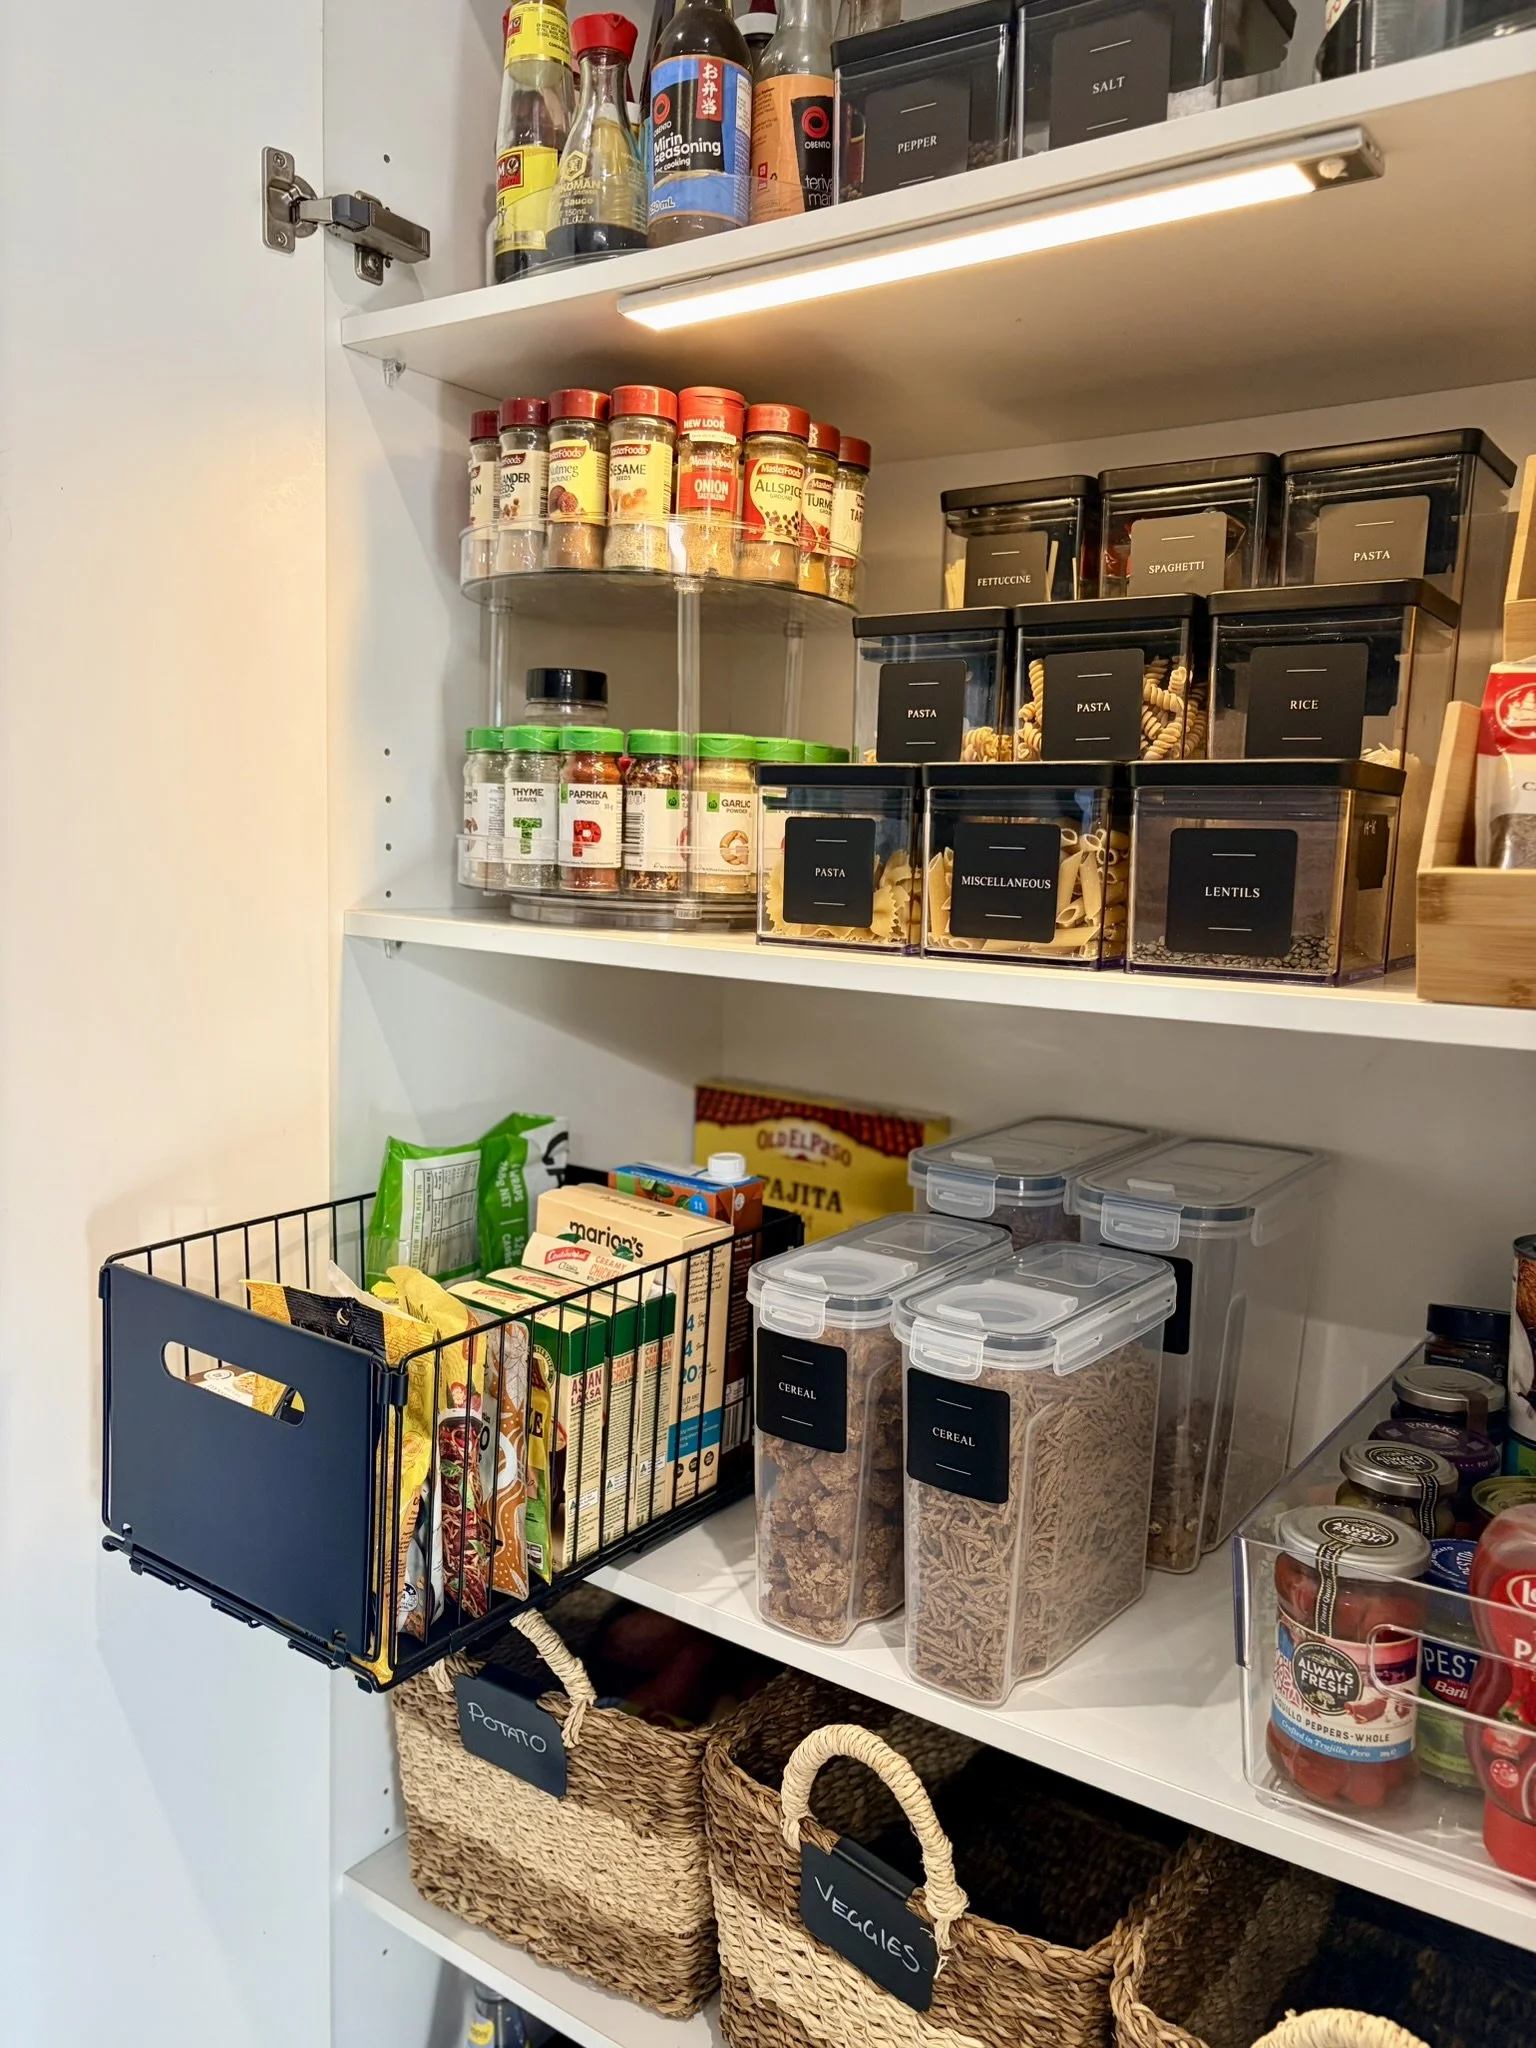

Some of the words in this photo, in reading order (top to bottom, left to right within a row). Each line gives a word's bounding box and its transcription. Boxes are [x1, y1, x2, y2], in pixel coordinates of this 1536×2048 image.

[701, 62, 719, 116] お弁当
[1091, 76, 1126, 95] SALT
[654, 132, 683, 152] Mirin
[804, 140, 832, 150] OBENTO
[898, 135, 938, 154] PEPPER
[654, 137, 722, 167] seasoning
[664, 157, 691, 172] cooking
[683, 419, 702, 429] NEW
[702, 418, 726, 429] LOOK
[609, 462, 647, 477] SESAME
[761, 464, 803, 478] MasterFoods
[694, 479, 729, 496] ONION
[1352, 548, 1391, 563] PASTA
[1147, 560, 1206, 576] SPAGHETTI
[977, 574, 1032, 588] FETTUCCINE
[1076, 701, 1111, 714] PASTA
[1289, 698, 1319, 711] RICE
[907, 708, 937, 719] PASTA
[512, 788, 544, 797] THYME
[569, 790, 608, 799] PAPRIKA
[721, 799, 751, 808] GARLIC
[814, 867, 846, 878] PASTA
[960, 874, 1052, 890] MISCELLANEOUS
[1205, 885, 1261, 899] LENTILS
[500, 1188, 512, 1208] NET
[569, 1220, 644, 1259] marion's
[595, 1256, 628, 1272] CREAMY
[686, 1314, 695, 1332] 4
[571, 1369, 603, 1397] ASAN
[778, 1381, 817, 1401] CEREAL
[932, 1426, 976, 1447] CEREAL
[1298, 1657, 1354, 1685] ALWAYS
[1301, 1669, 1349, 1697] FRESH
[468, 1701, 548, 1755] POTATO
[1305, 1719, 1391, 1743] PEPPERS-WHOLE
[1281, 1719, 1305, 1740] Crafted
[1305, 1735, 1313, 1744] in
[1350, 1749, 1371, 1758] Peru
[813, 1875, 922, 1976] VEGGIES
